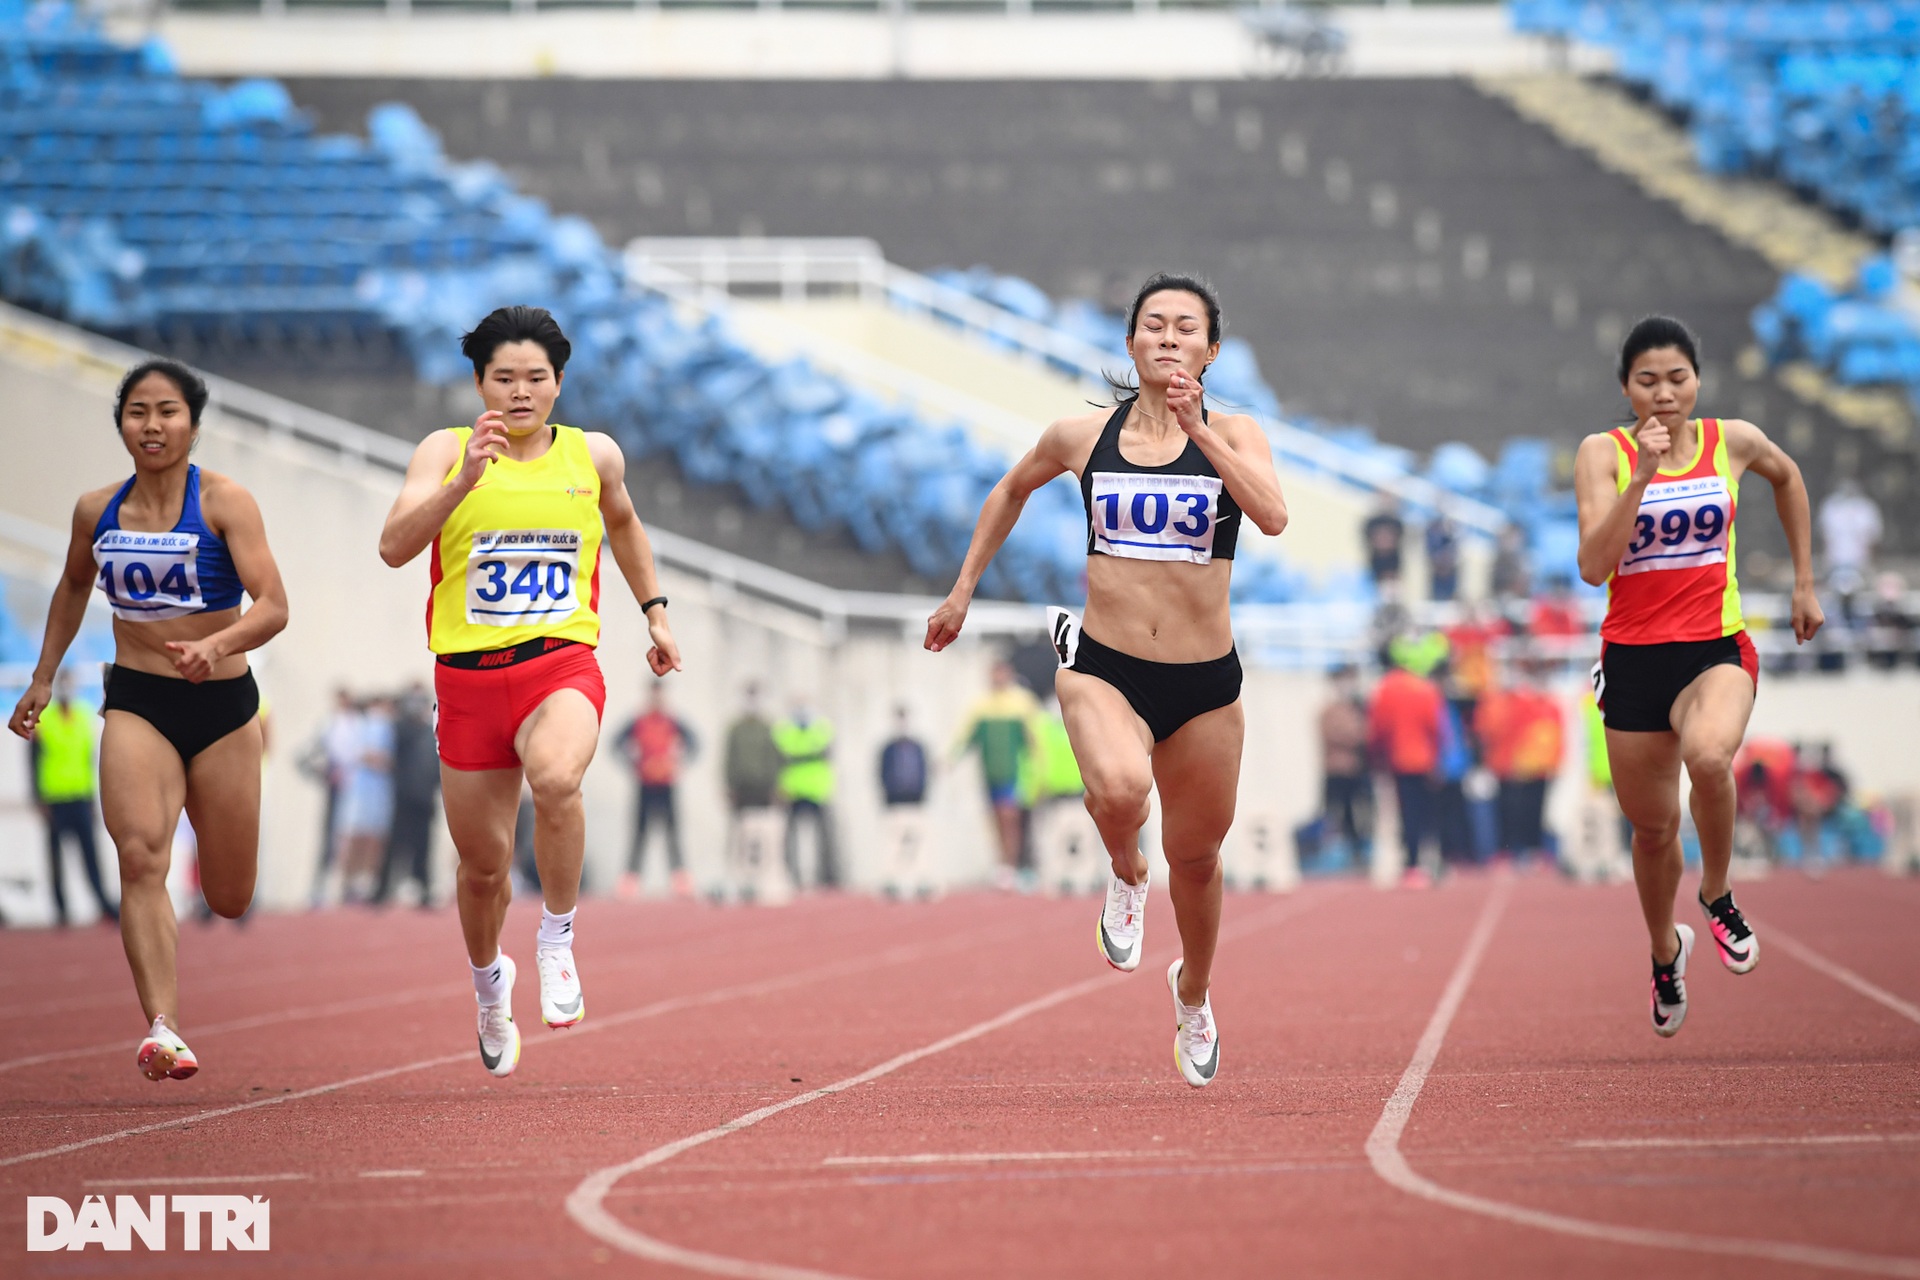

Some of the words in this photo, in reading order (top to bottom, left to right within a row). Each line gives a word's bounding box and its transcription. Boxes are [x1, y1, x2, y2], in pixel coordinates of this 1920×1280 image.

[1096, 493, 1209, 537] 103
[1628, 503, 1724, 554] 399
[536, 534, 551, 544] KINH
[100, 561, 195, 602] 104
[475, 560, 572, 603] 340
[477, 648, 517, 667] NIKE
